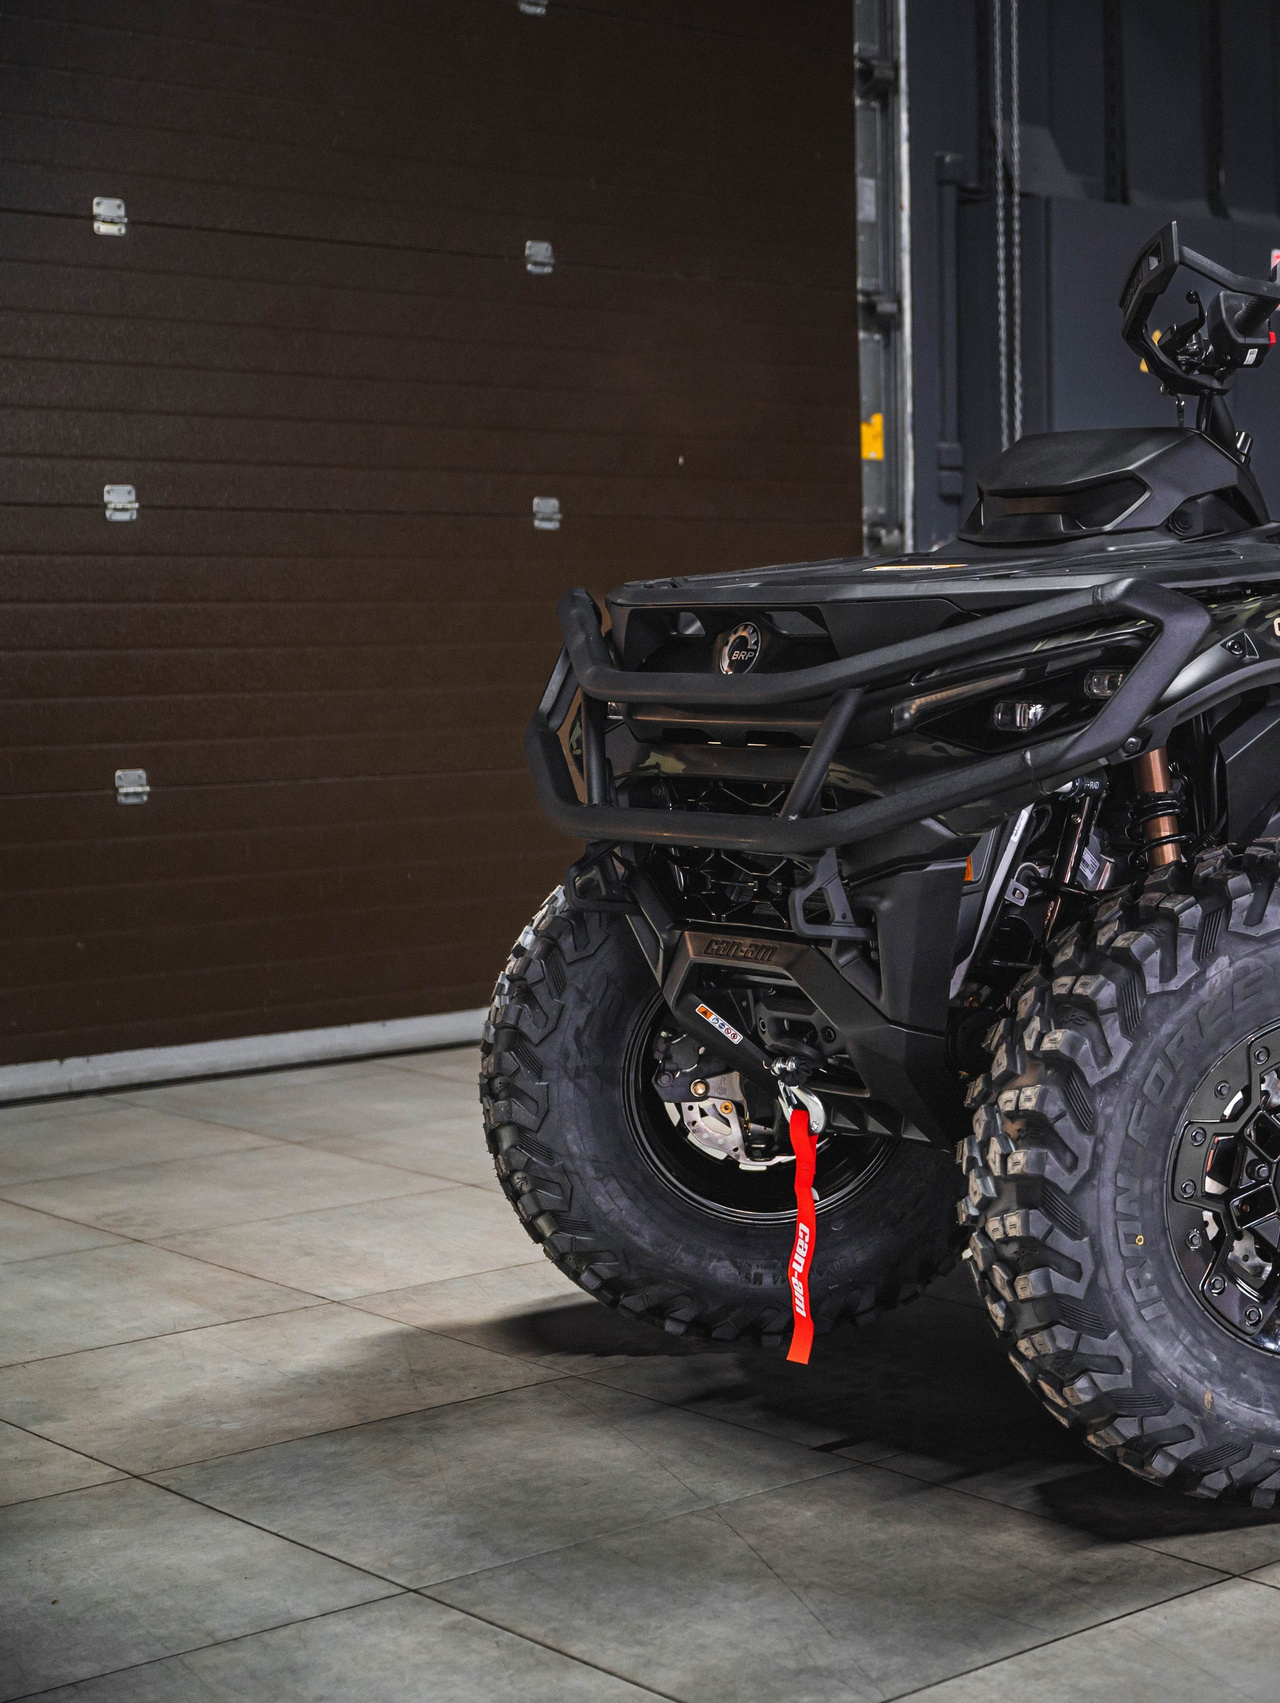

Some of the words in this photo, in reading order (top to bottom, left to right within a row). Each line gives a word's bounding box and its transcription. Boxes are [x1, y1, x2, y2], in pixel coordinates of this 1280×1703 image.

[731, 650, 755, 661] BRP
[703, 938, 779, 962] can-am
[790, 1221, 811, 1319] can-am
